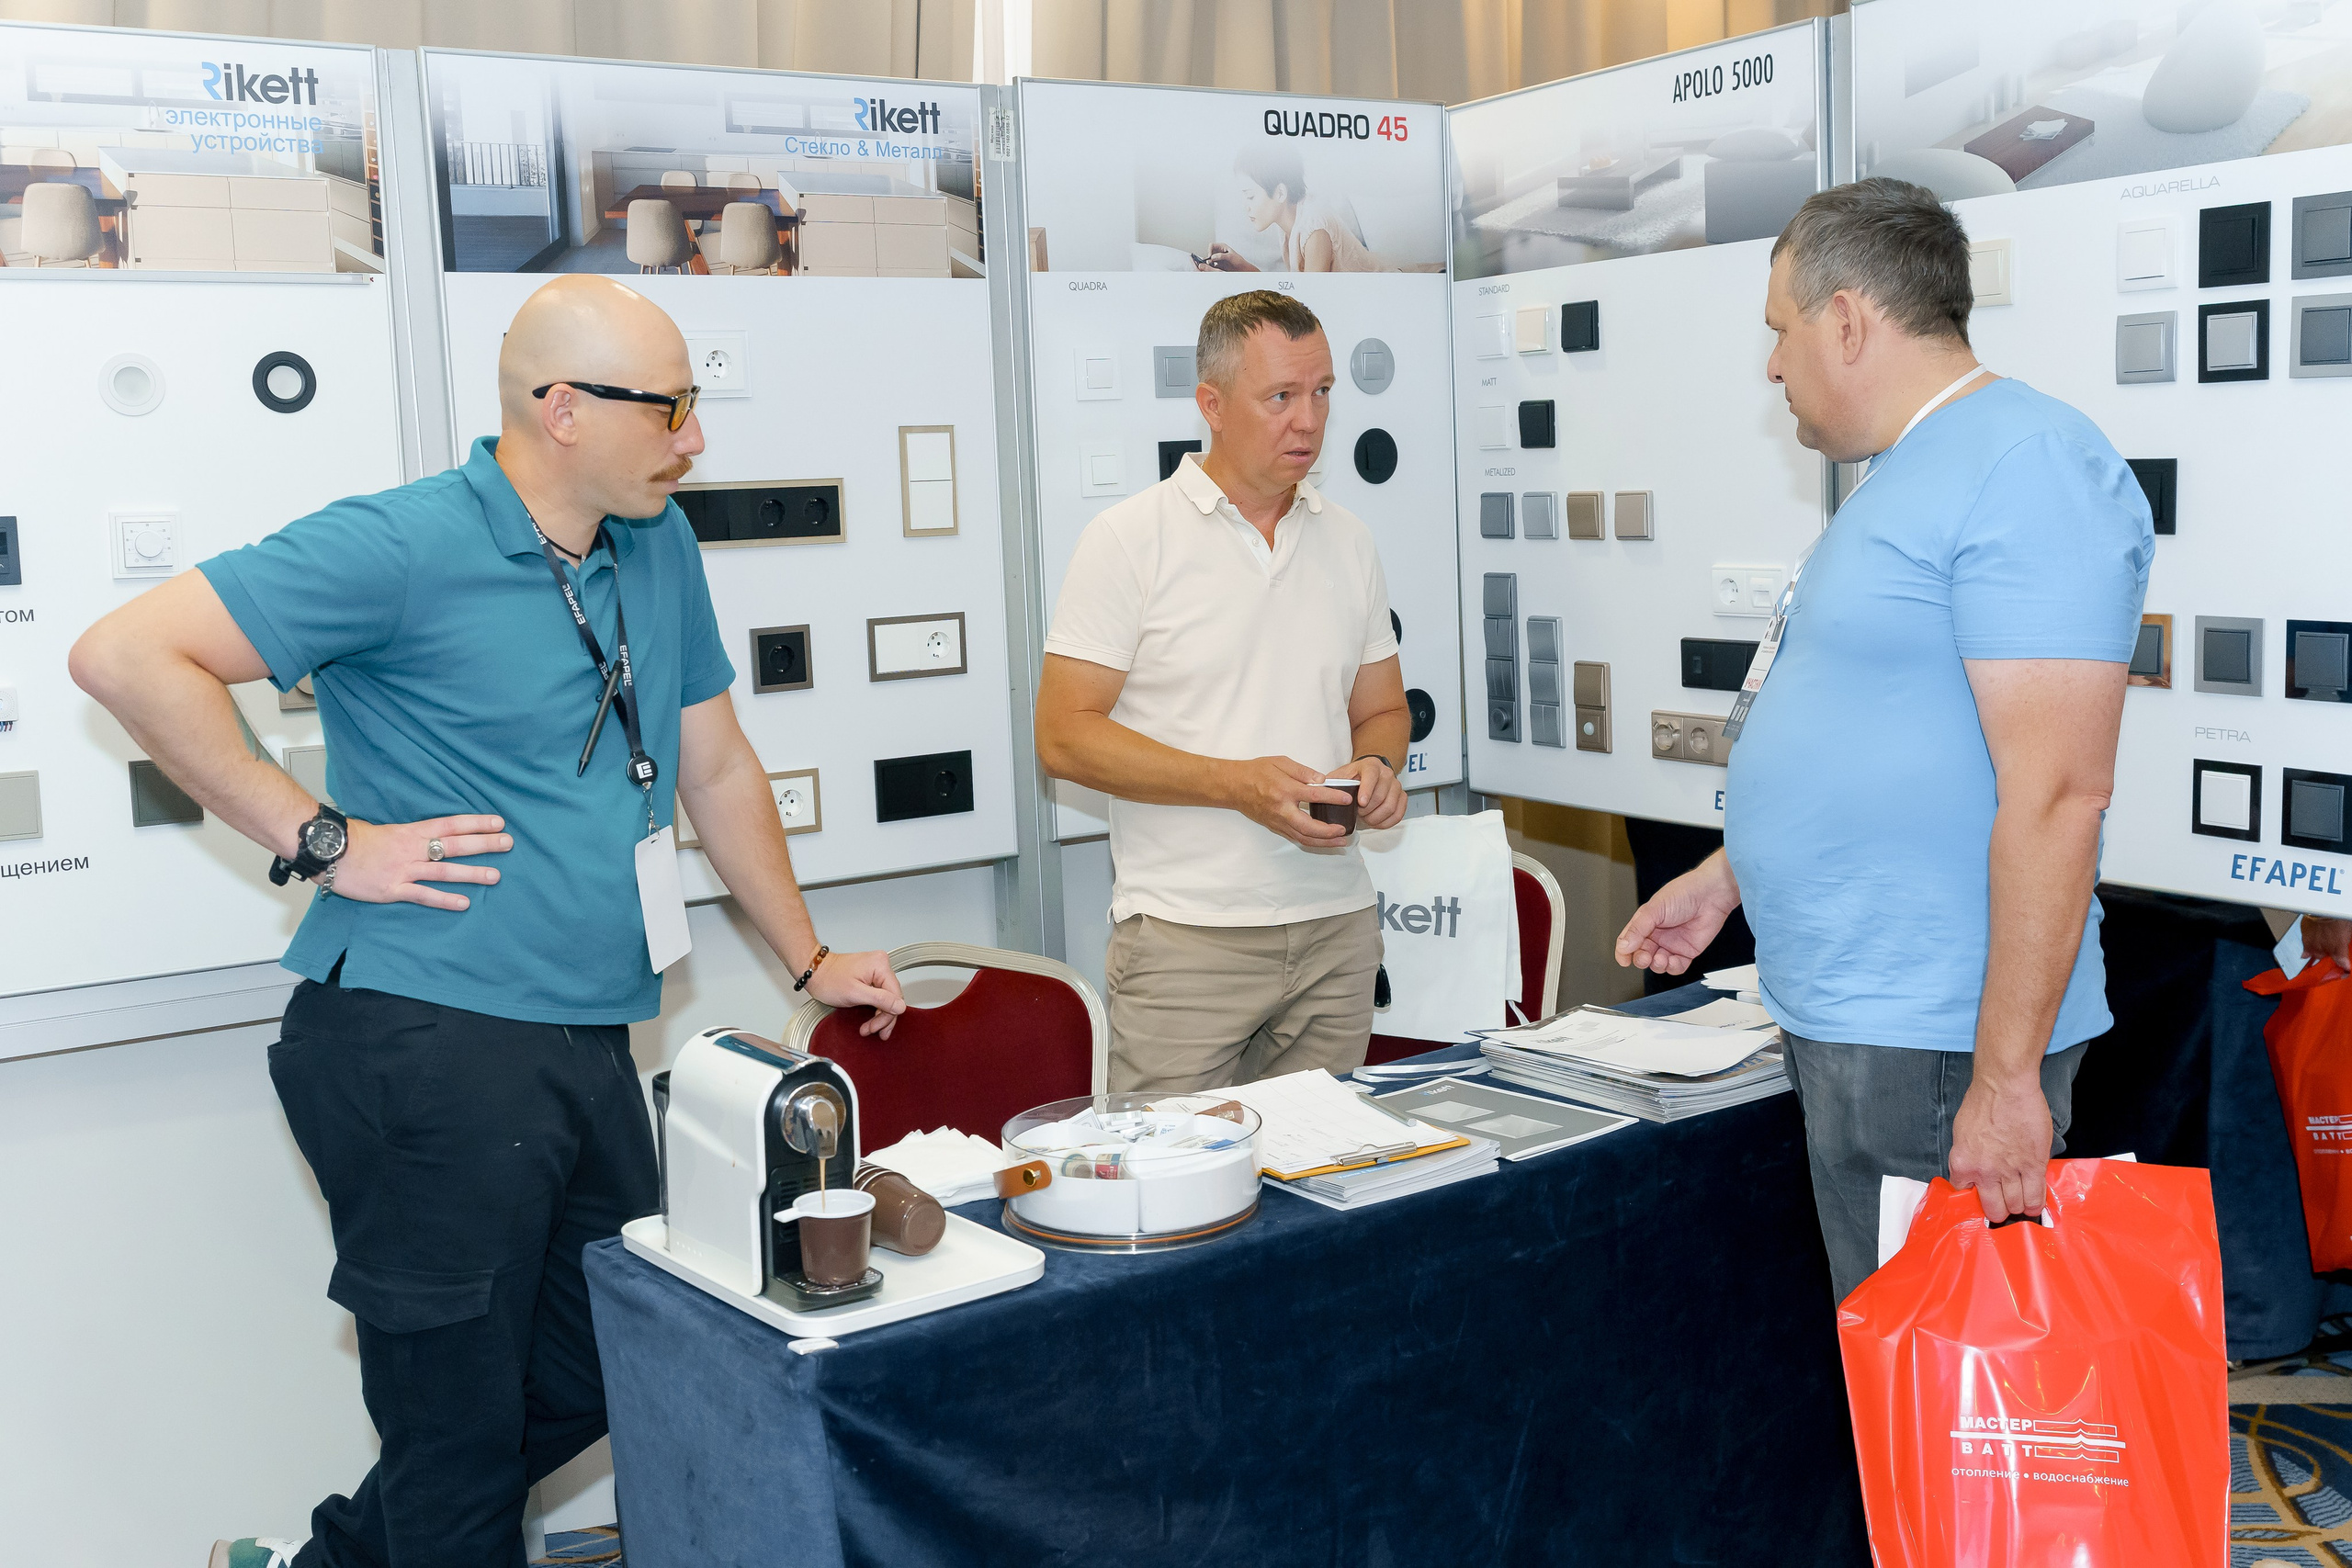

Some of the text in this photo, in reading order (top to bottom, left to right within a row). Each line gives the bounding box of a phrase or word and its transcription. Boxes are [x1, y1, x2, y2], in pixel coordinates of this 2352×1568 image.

[201, 62, 319, 105] Rikett
[1672, 53, 1773, 104] APOLO 5000
[165, 109, 322, 132] электронные
[854, 96, 941, 134] Rikett
[1264, 109, 1408, 141] QUADRO 45
[190, 132, 324, 155] устройства
[785, 136, 943, 160] Стекло & Металл
[2120, 175, 2221, 200] AQUARELLA
[1069, 281, 1108, 291] QUADRA
[1278, 281, 1295, 290] SIZA
[1478, 284, 1510, 296] STANDARD
[1481, 378, 1498, 387] MATT
[1485, 468, 1516, 477] METALIZED
[563, 583, 586, 625] EFAPEL
[619, 644, 632, 687] EFAPEL
[2195, 727, 2251, 742] PETRA
[0, 856, 89, 880] щением
[2231, 853, 2342, 895] EFAPEL
[1377, 891, 1462, 938] kett
[1960, 1416, 2033, 1432] МАСТЕР
[1951, 1468, 2130, 1487] отопление водоснабжение
